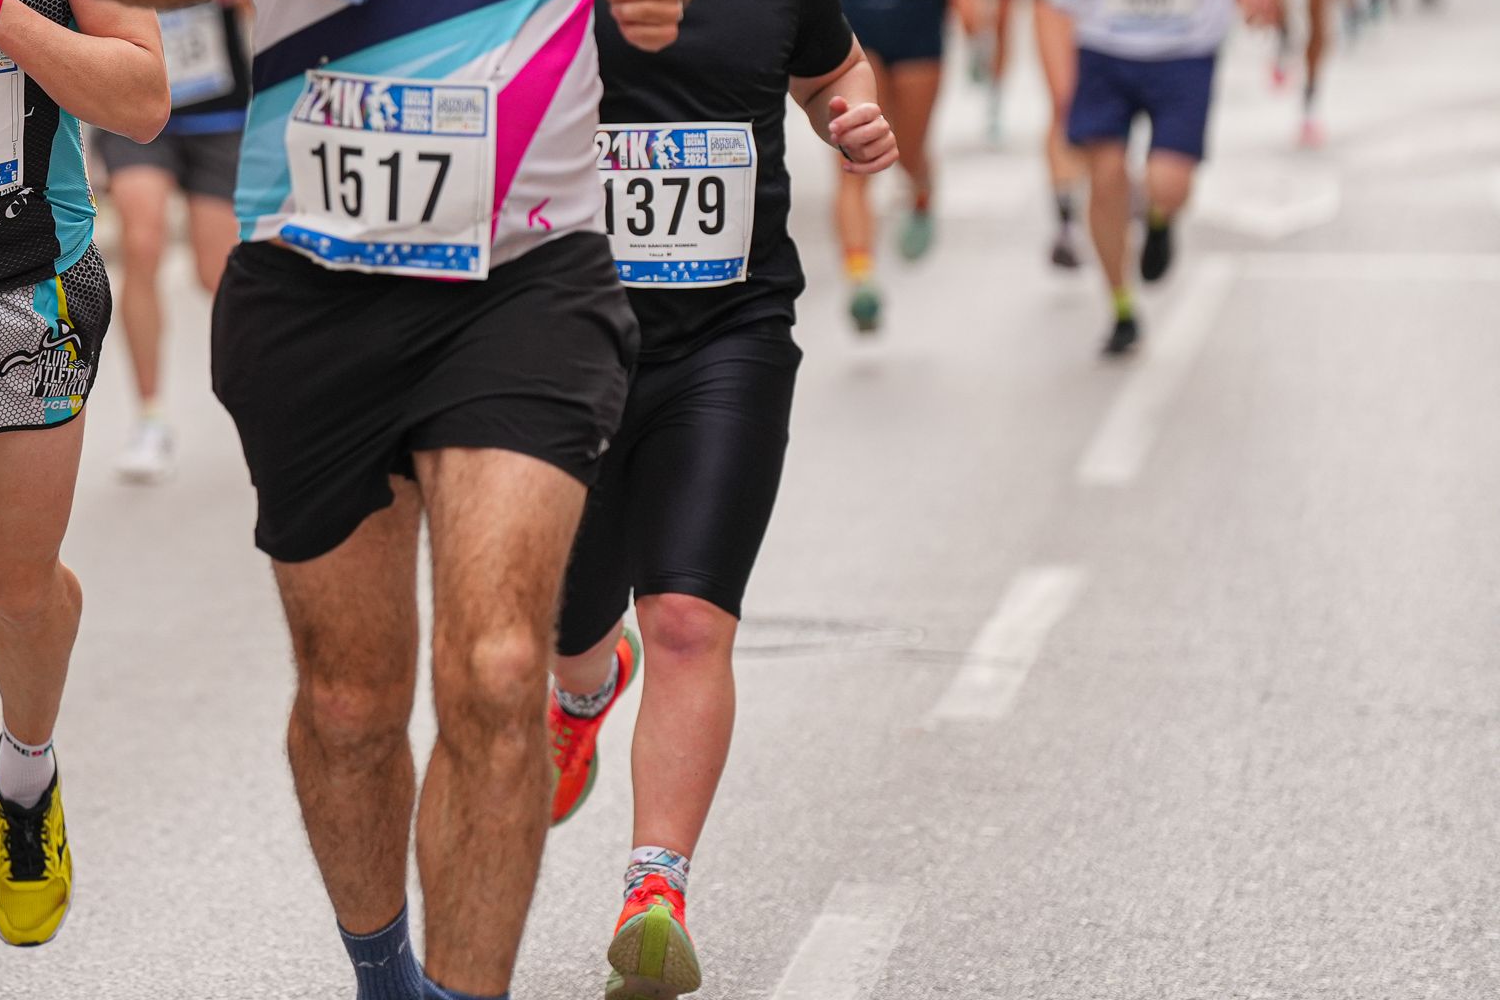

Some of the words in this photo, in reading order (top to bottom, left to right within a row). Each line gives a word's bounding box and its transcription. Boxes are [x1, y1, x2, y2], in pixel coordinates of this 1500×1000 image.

[310, 141, 453, 225] 1517
[604, 175, 726, 237] 1379
[38, 350, 70, 367] CLUB
[43, 379, 88, 397] TRIATLO
